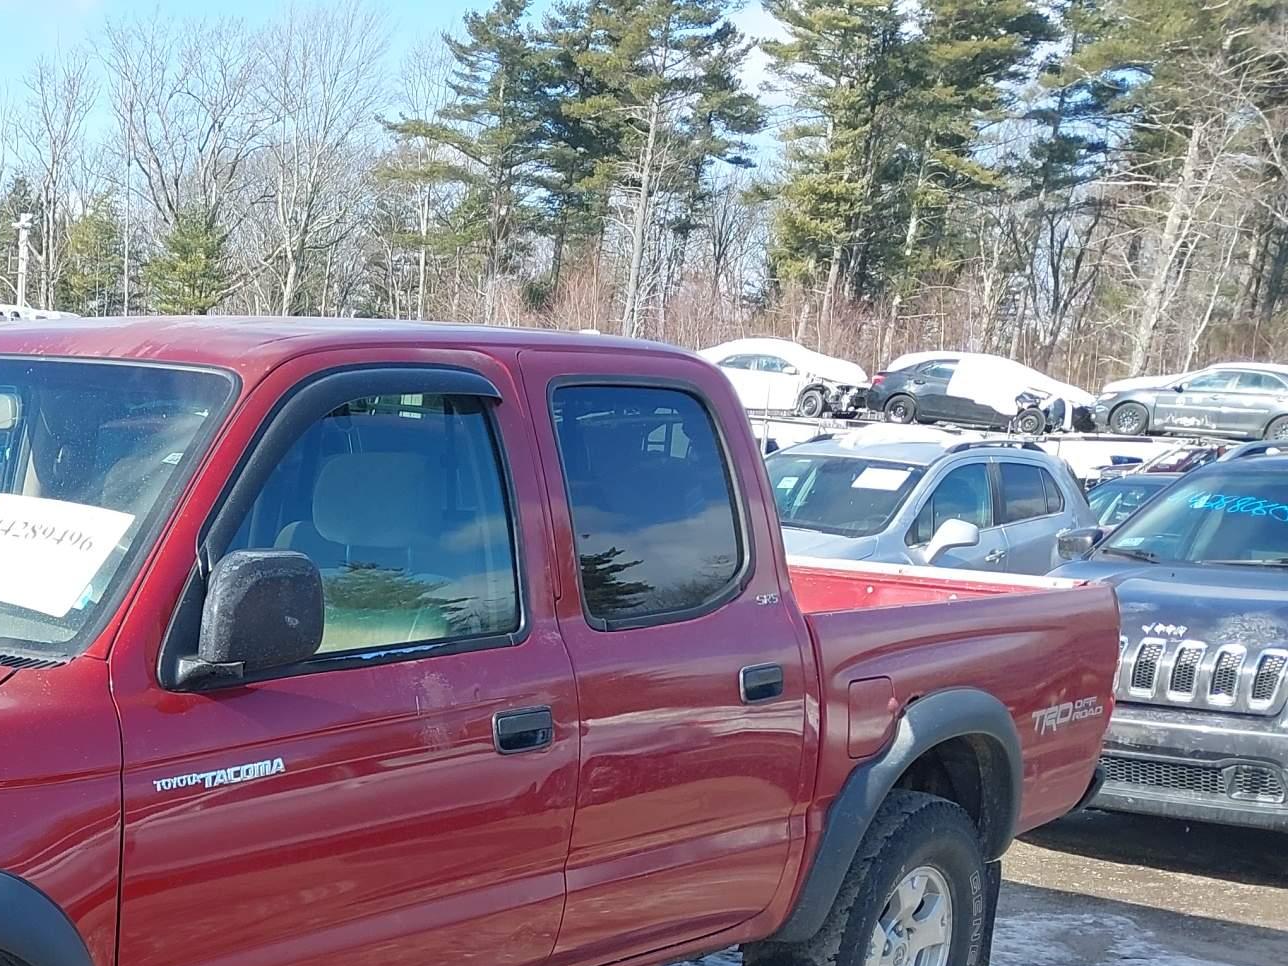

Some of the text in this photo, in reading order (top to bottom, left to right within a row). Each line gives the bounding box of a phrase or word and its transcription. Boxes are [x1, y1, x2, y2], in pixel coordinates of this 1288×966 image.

[755, 592, 779, 606] SR5
[1074, 695, 1098, 709] OFF
[1032, 701, 1073, 736] TRD
[1072, 705, 1103, 721] ROAD
[152, 757, 286, 792] TOYOTA TACOMA
